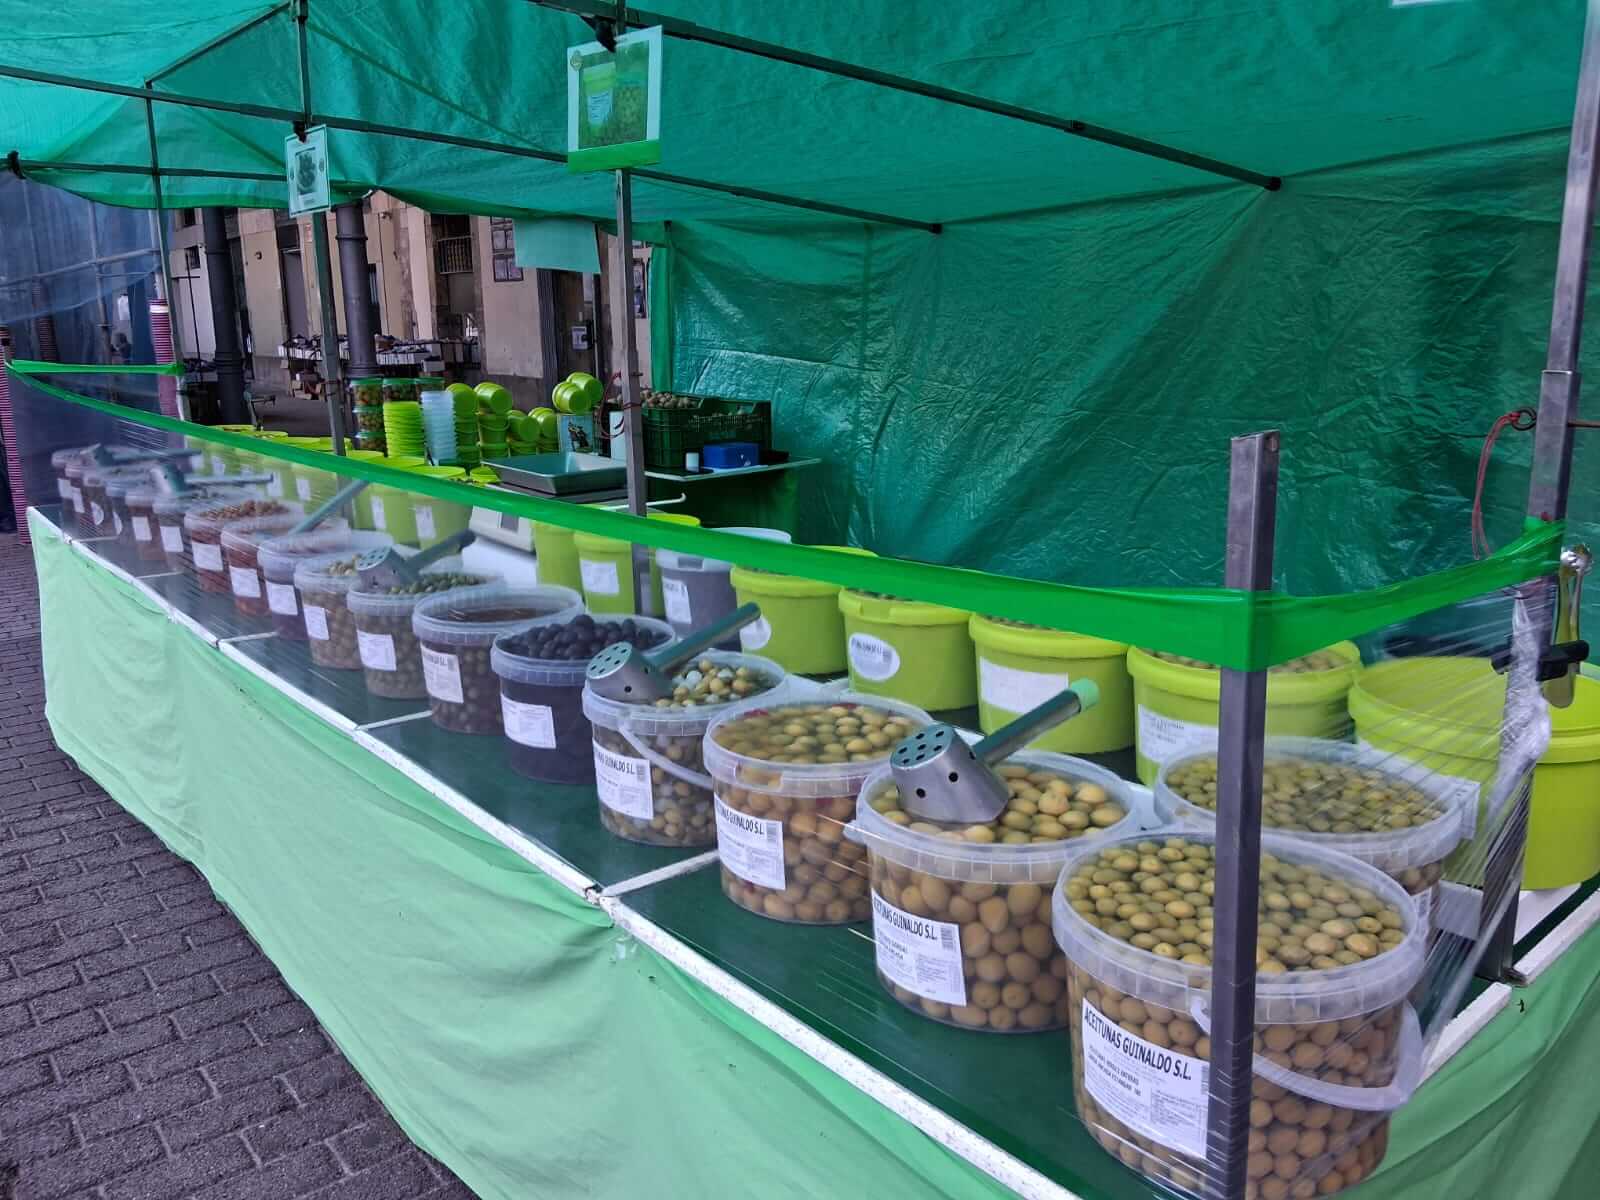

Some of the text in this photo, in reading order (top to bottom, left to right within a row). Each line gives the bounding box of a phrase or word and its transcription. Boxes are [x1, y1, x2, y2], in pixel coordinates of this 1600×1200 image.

[893, 911, 924, 937] GUINALDO
[924, 924, 938, 940] S.L.
[1084, 1007, 1122, 1049] ACEITUNAS
[1122, 1037, 1172, 1073] GUINALDO
[1173, 1060, 1192, 1081] S.L.
